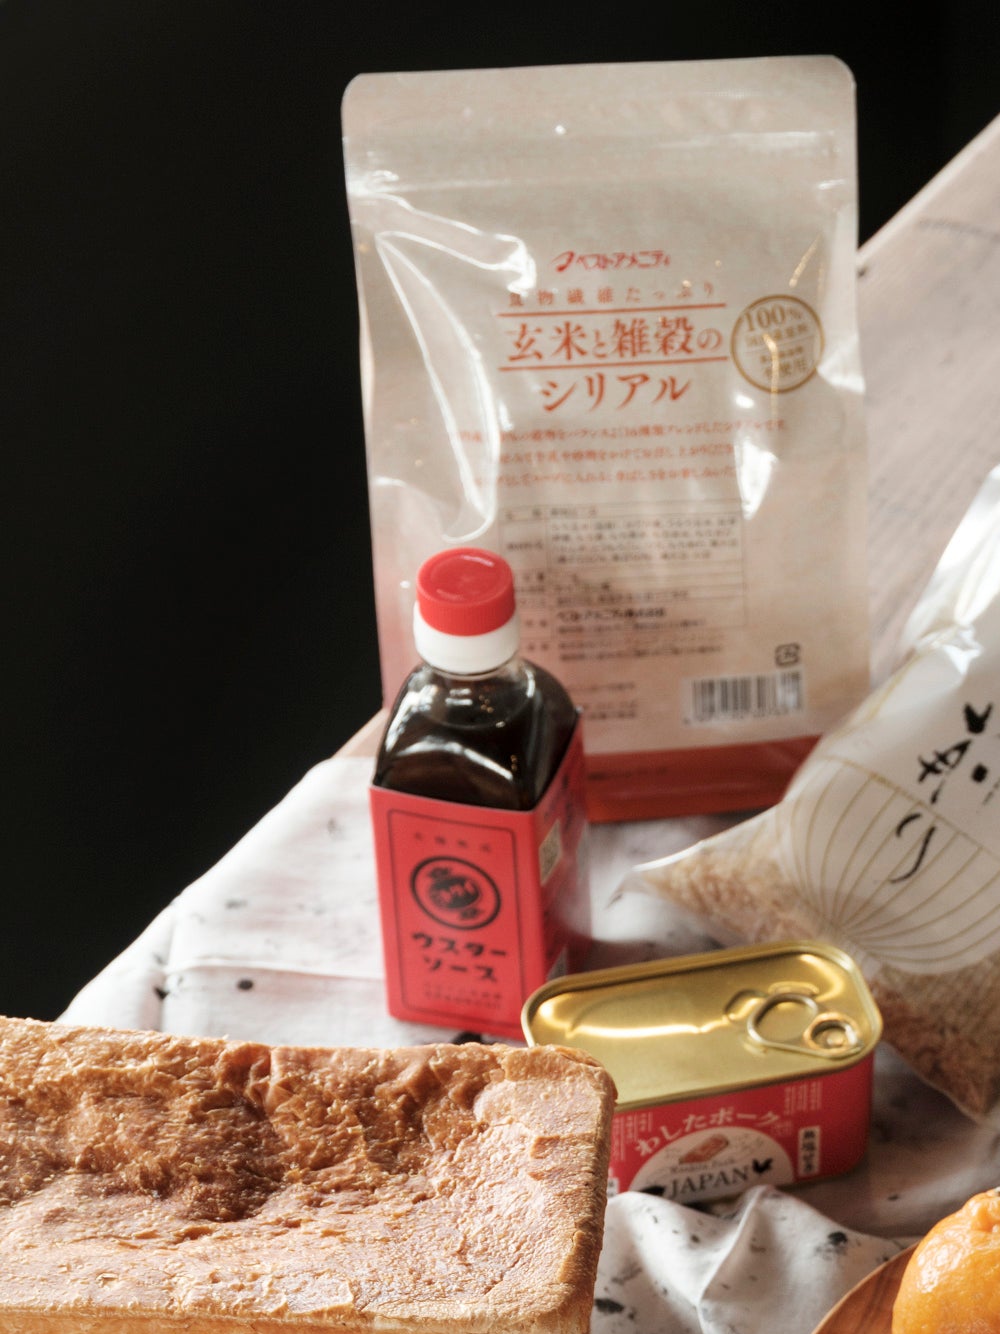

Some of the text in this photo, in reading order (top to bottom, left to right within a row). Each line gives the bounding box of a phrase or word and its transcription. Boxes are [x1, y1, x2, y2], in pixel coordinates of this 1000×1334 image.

[506, 316, 724, 363] 玄米と雑穀の
[539, 371, 692, 413] シリアル
[423, 956, 498, 983] ソース
[634, 1106, 780, 1157] わしたポーク
[669, 1165, 749, 1197] JAPAN
